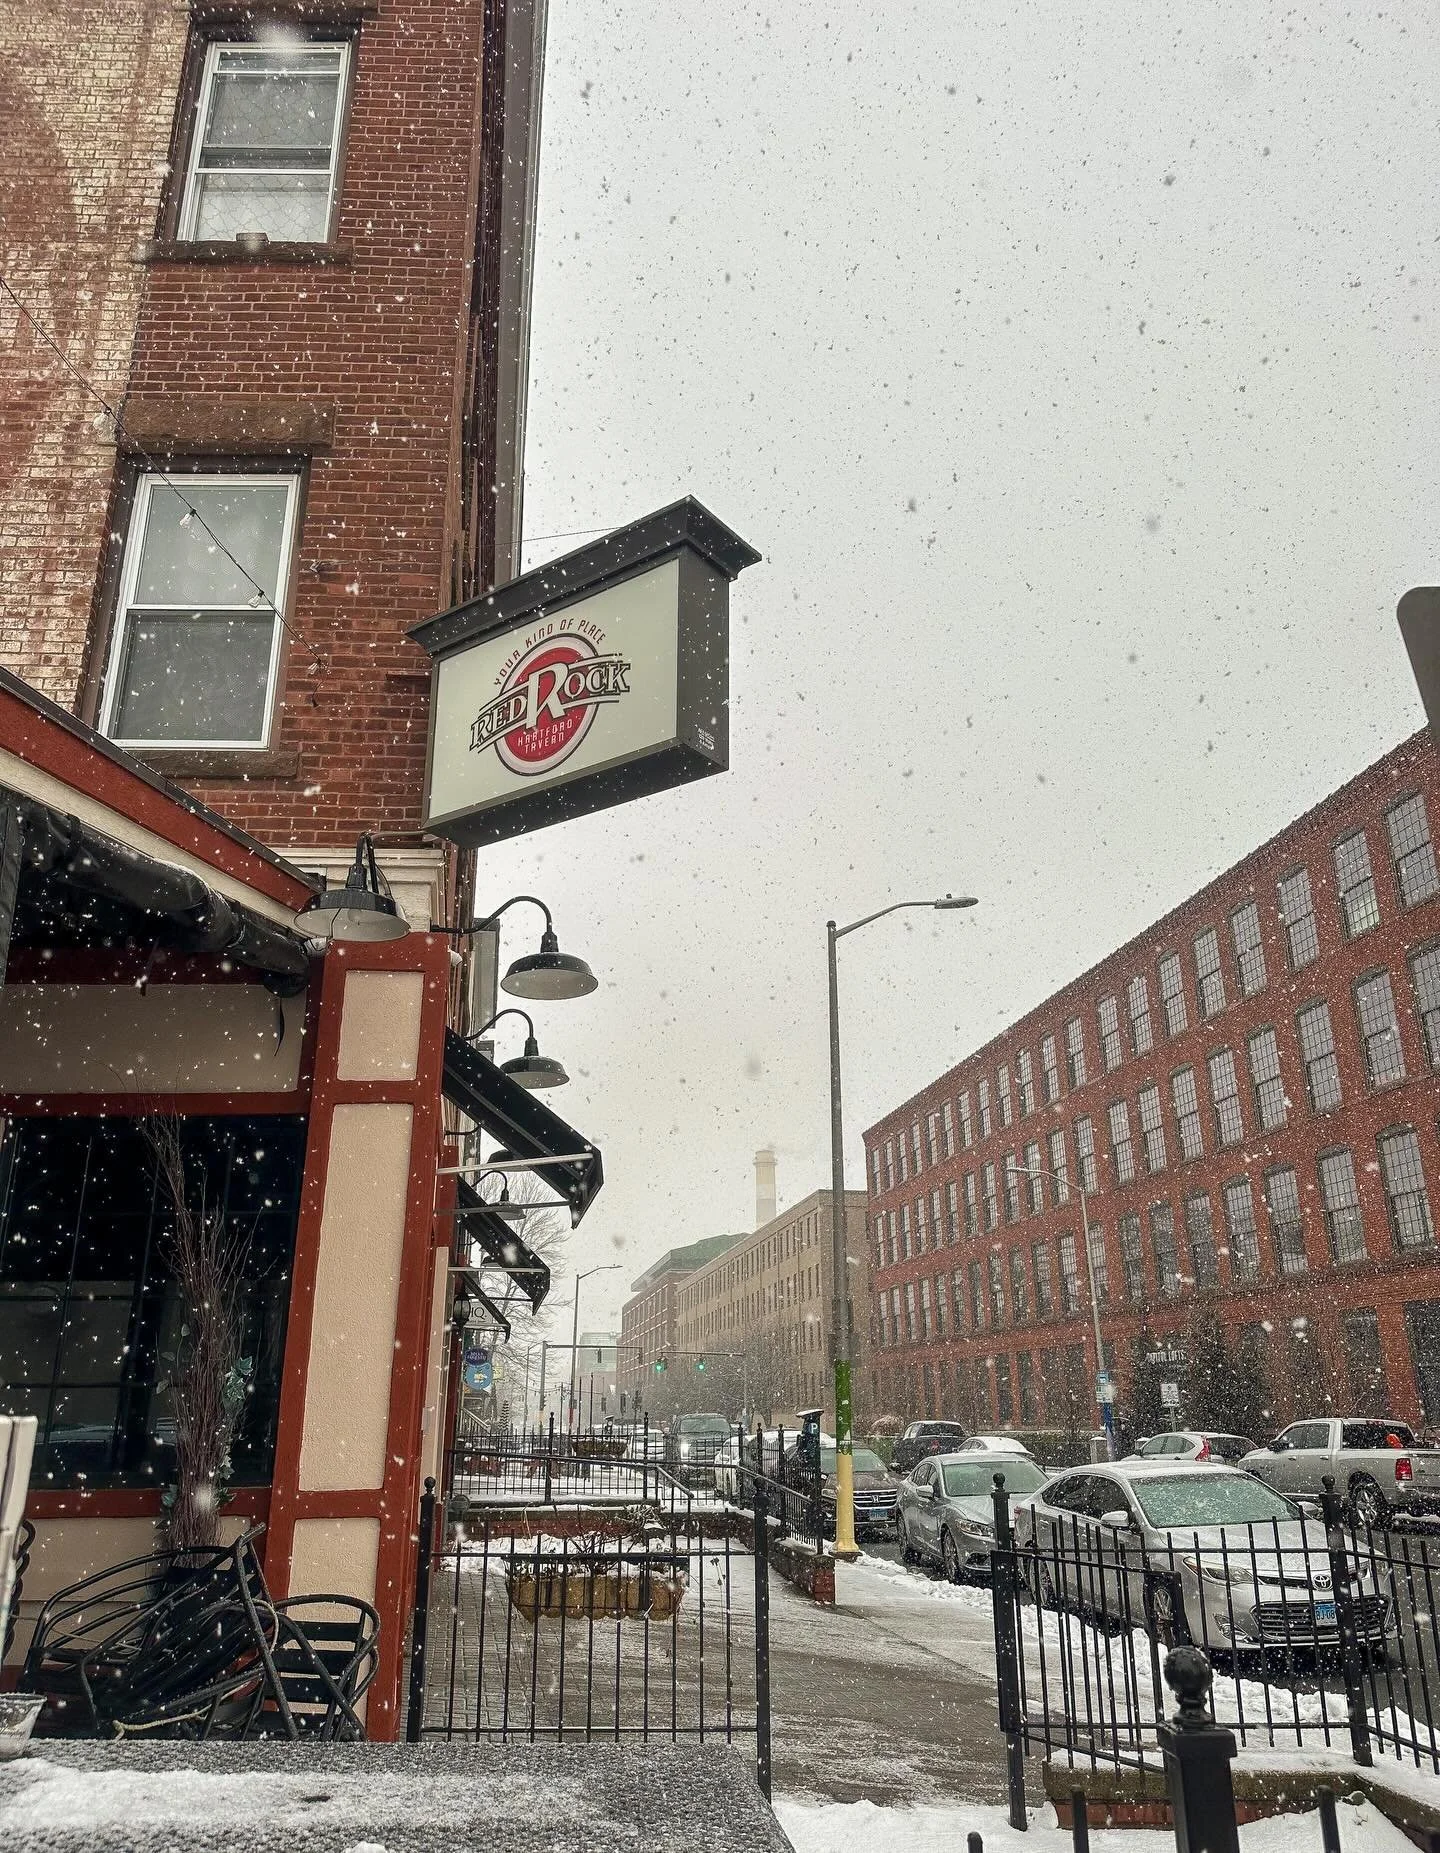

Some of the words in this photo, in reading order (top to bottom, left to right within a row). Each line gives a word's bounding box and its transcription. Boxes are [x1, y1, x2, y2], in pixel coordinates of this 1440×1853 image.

[494, 650, 521, 686] YOUR
[525, 623, 553, 648] KIND
[559, 618, 574, 630] OF
[577, 619, 606, 645] PLACE
[469, 694, 528, 751] RED
[524, 661, 631, 729] ROCK
[517, 718, 573, 747] HARTFORD
[524, 732, 565, 754] TAVERN
[810, 1422, 818, 1434] P
